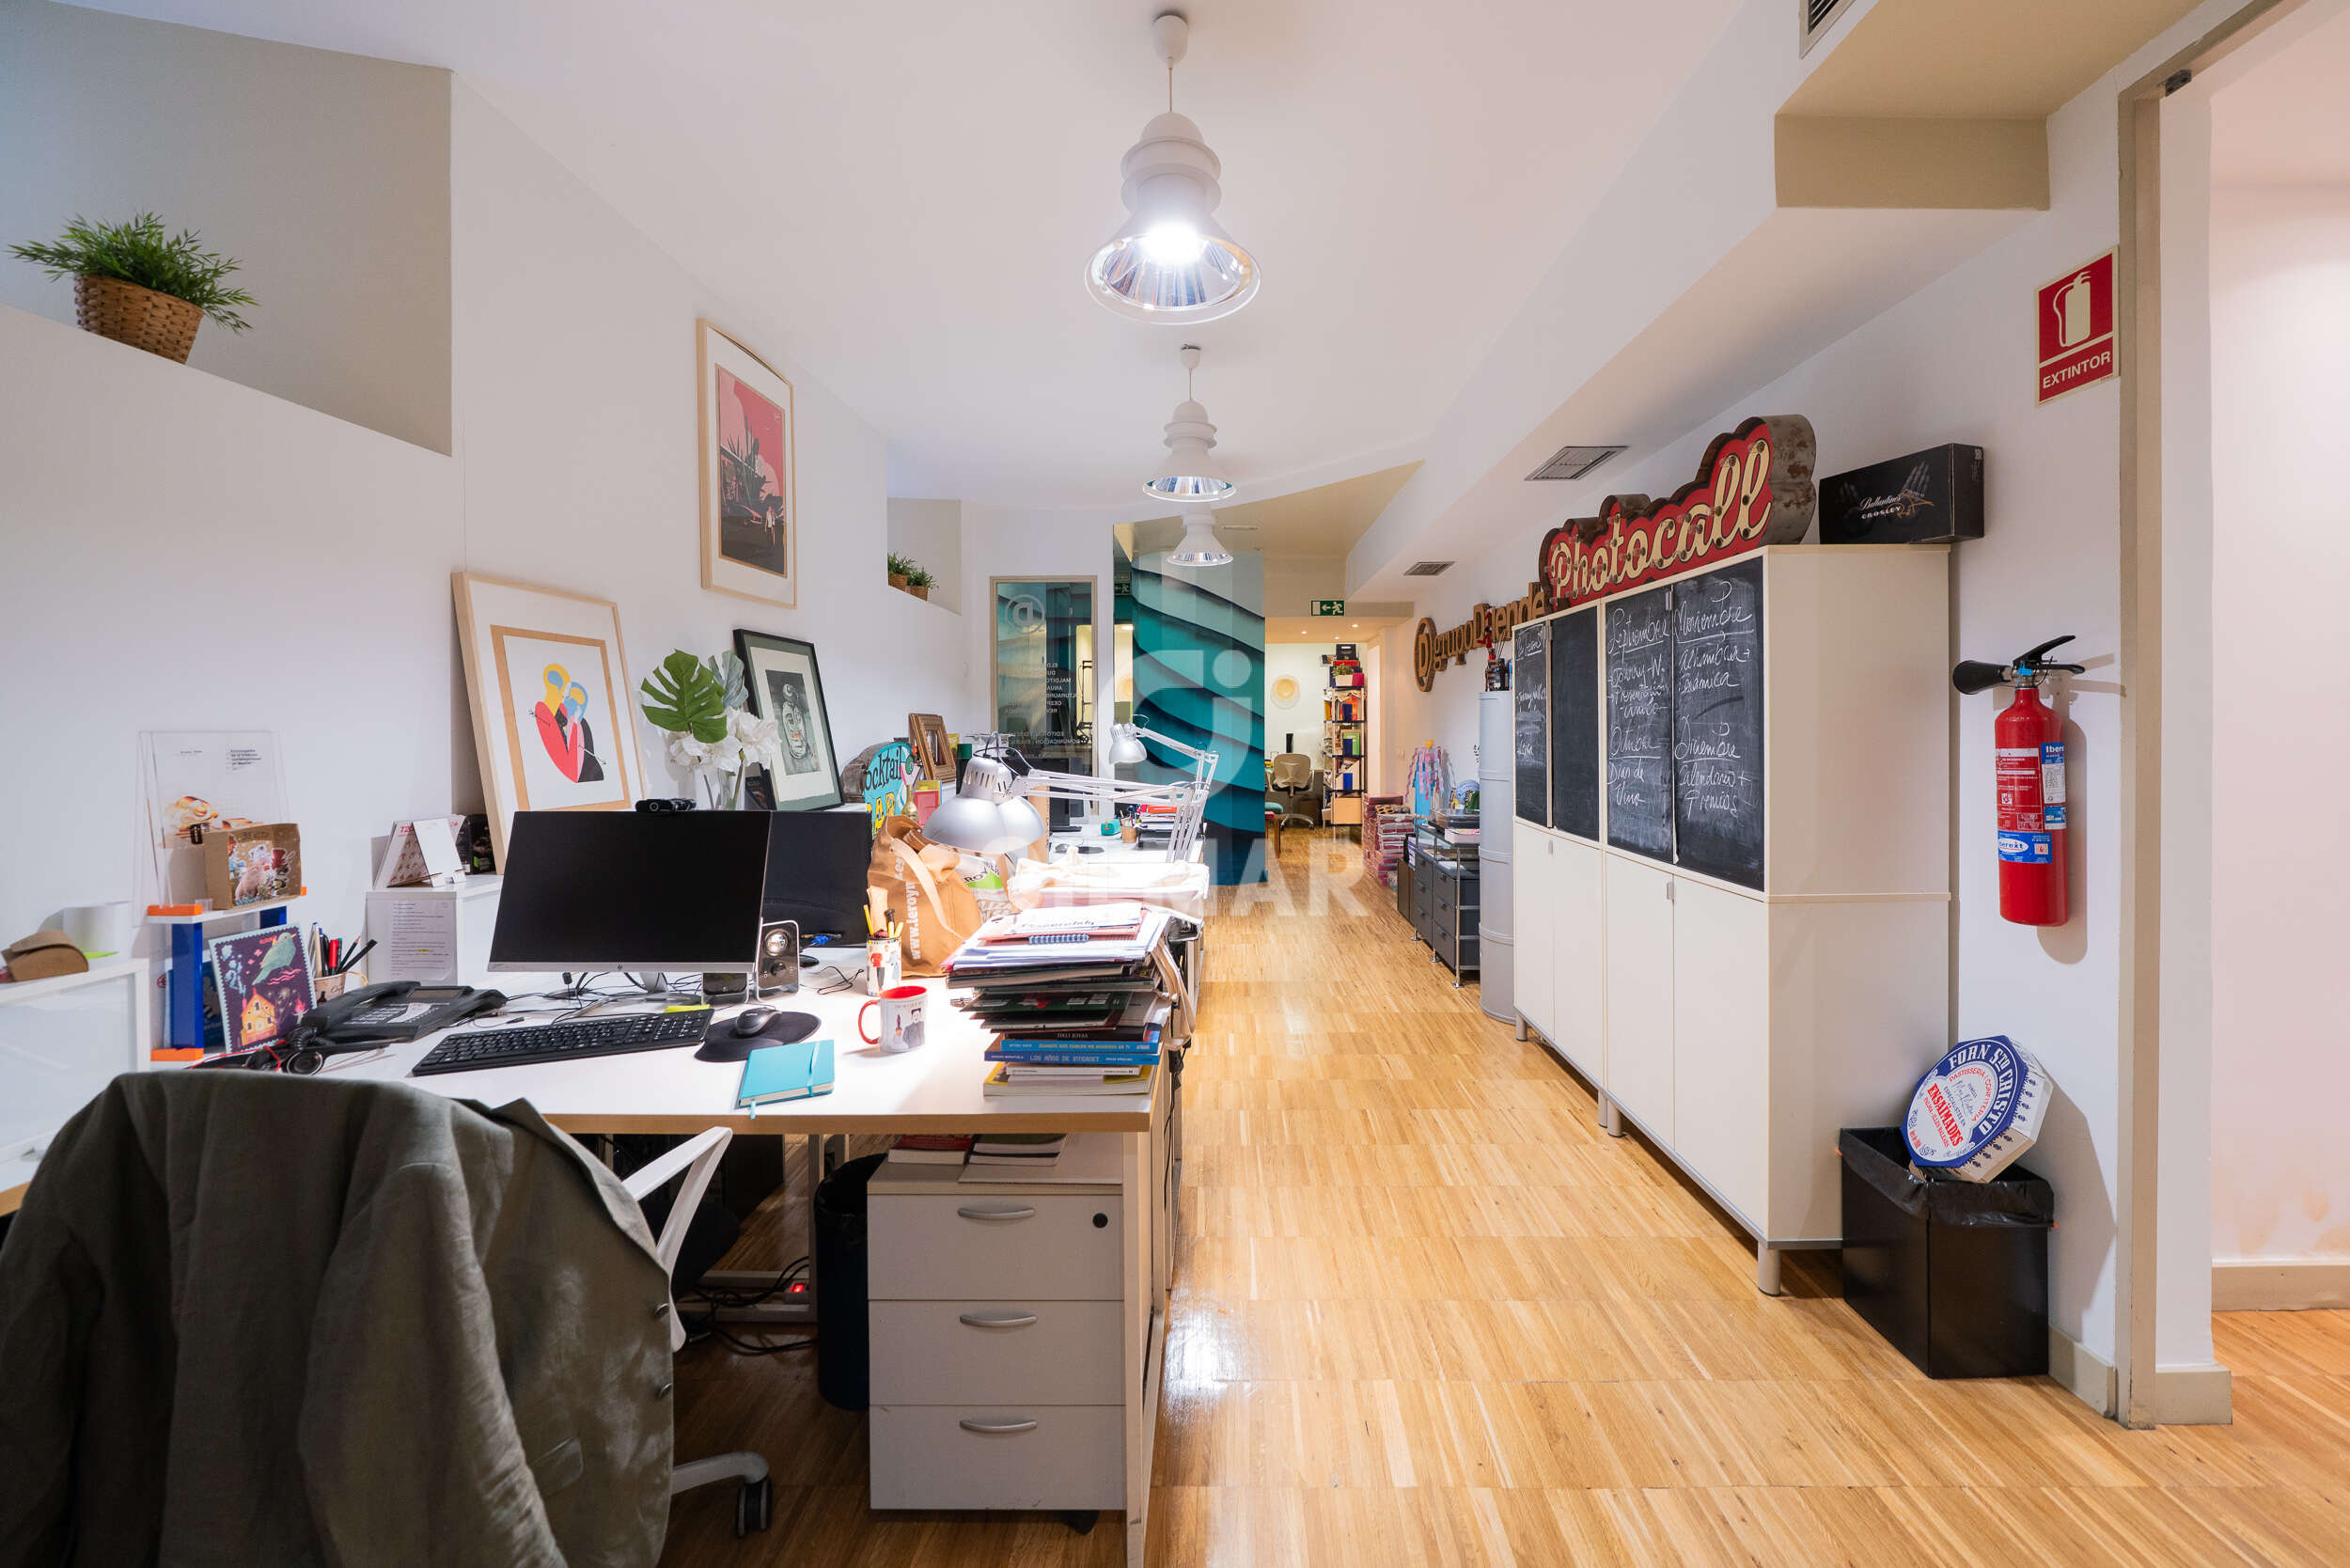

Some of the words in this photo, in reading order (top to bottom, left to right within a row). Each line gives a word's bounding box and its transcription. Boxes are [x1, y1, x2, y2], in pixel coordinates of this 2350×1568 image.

[2043, 351, 2110, 388] EXTINTOR
[1927, 1082, 1964, 1147] ENSAÏMADES
[1948, 1043, 1991, 1070] FORN
[1979, 1068, 2013, 1136] CRISTO
